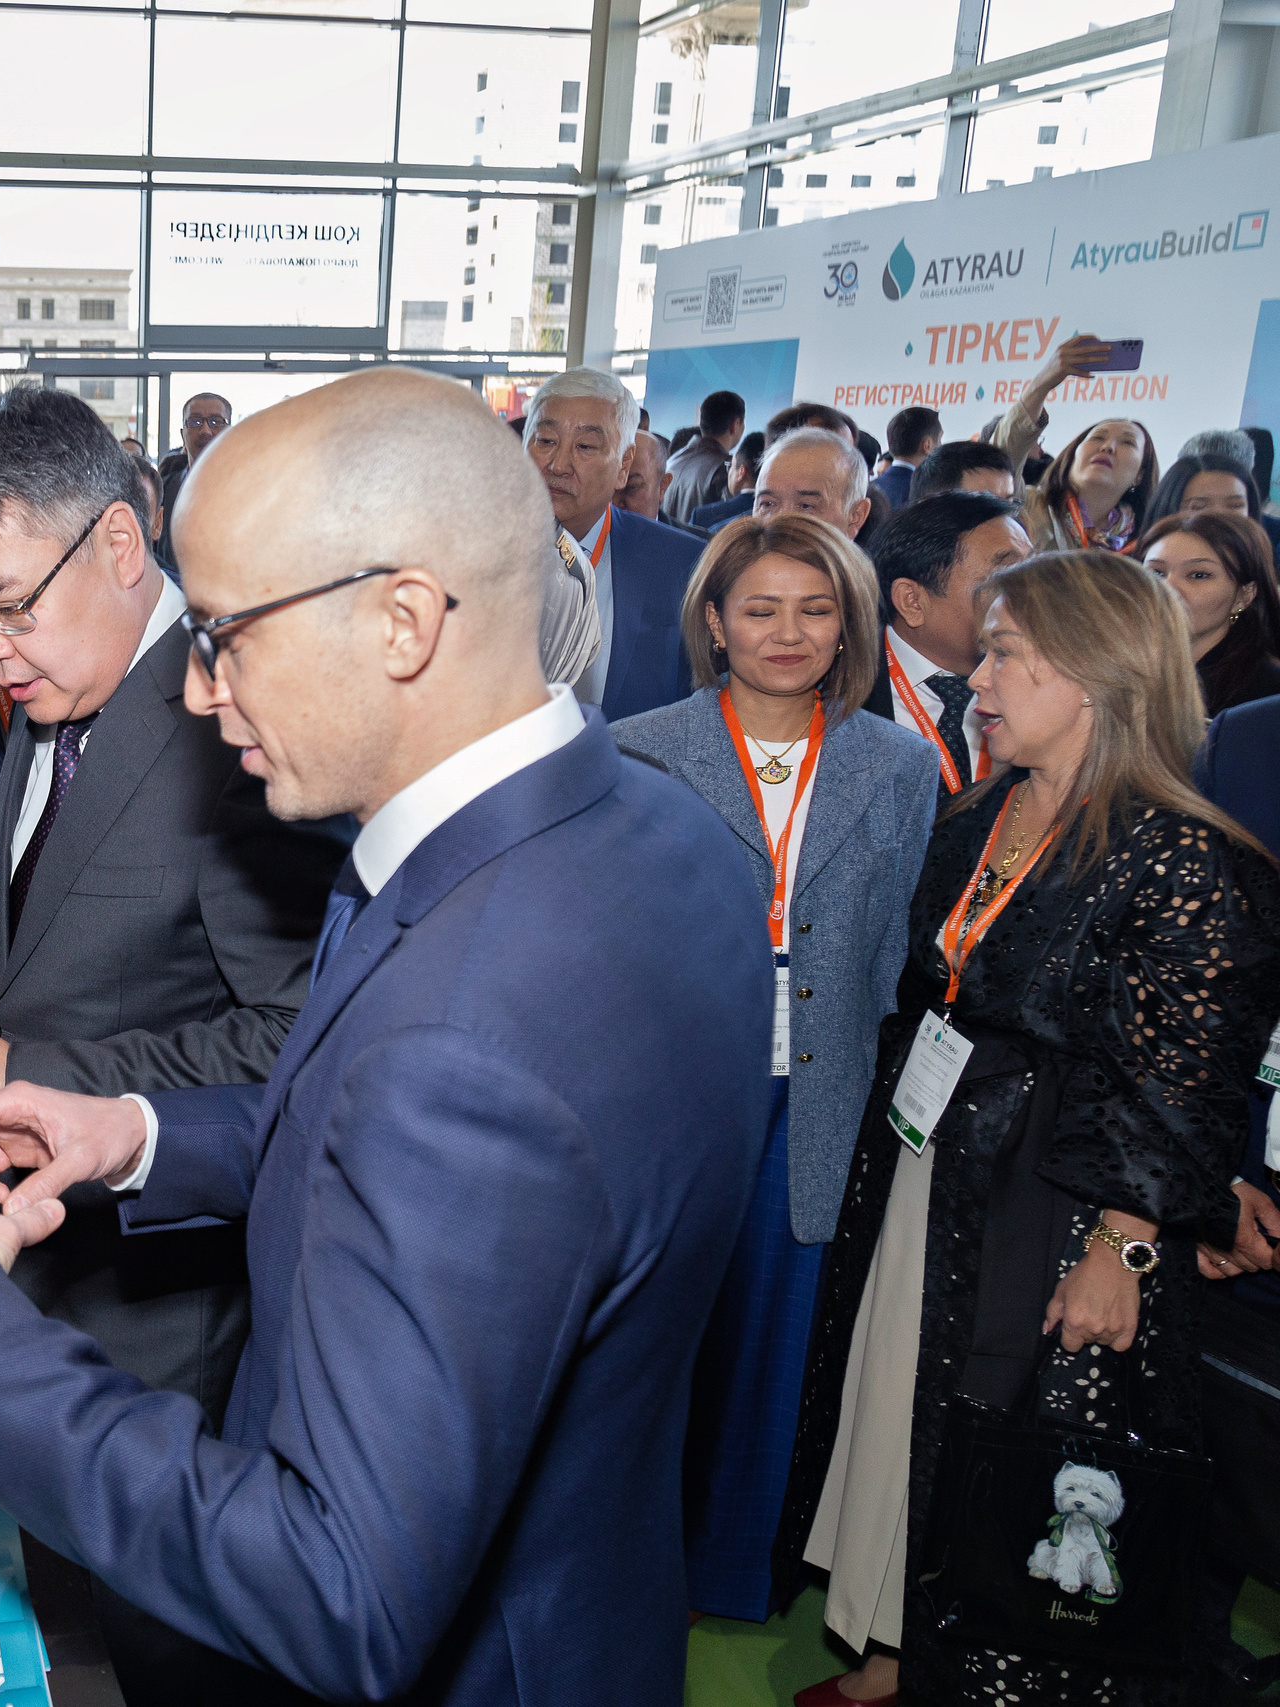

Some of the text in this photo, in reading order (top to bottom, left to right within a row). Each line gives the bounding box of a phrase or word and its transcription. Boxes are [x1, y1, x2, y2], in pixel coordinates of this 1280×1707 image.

[1070, 221, 1233, 274] AtyrauBuild
[922, 248, 1024, 287] ATYRAU
[833, 382, 968, 407] РЕГИСТРАЦИЯ
[993, 374, 1170, 403] RETRATION
[896, 676, 921, 717] INTERNATIONAL
[775, 834, 787, 884] INTERNATIONAL
[972, 892, 1010, 935] CONFERENCES
[940, 1039, 959, 1055] ATYRAU
[1260, 1064, 1280, 1081] VIP
[897, 1115, 910, 1132] VIP
[1045, 1600, 1099, 1625] Harrods
